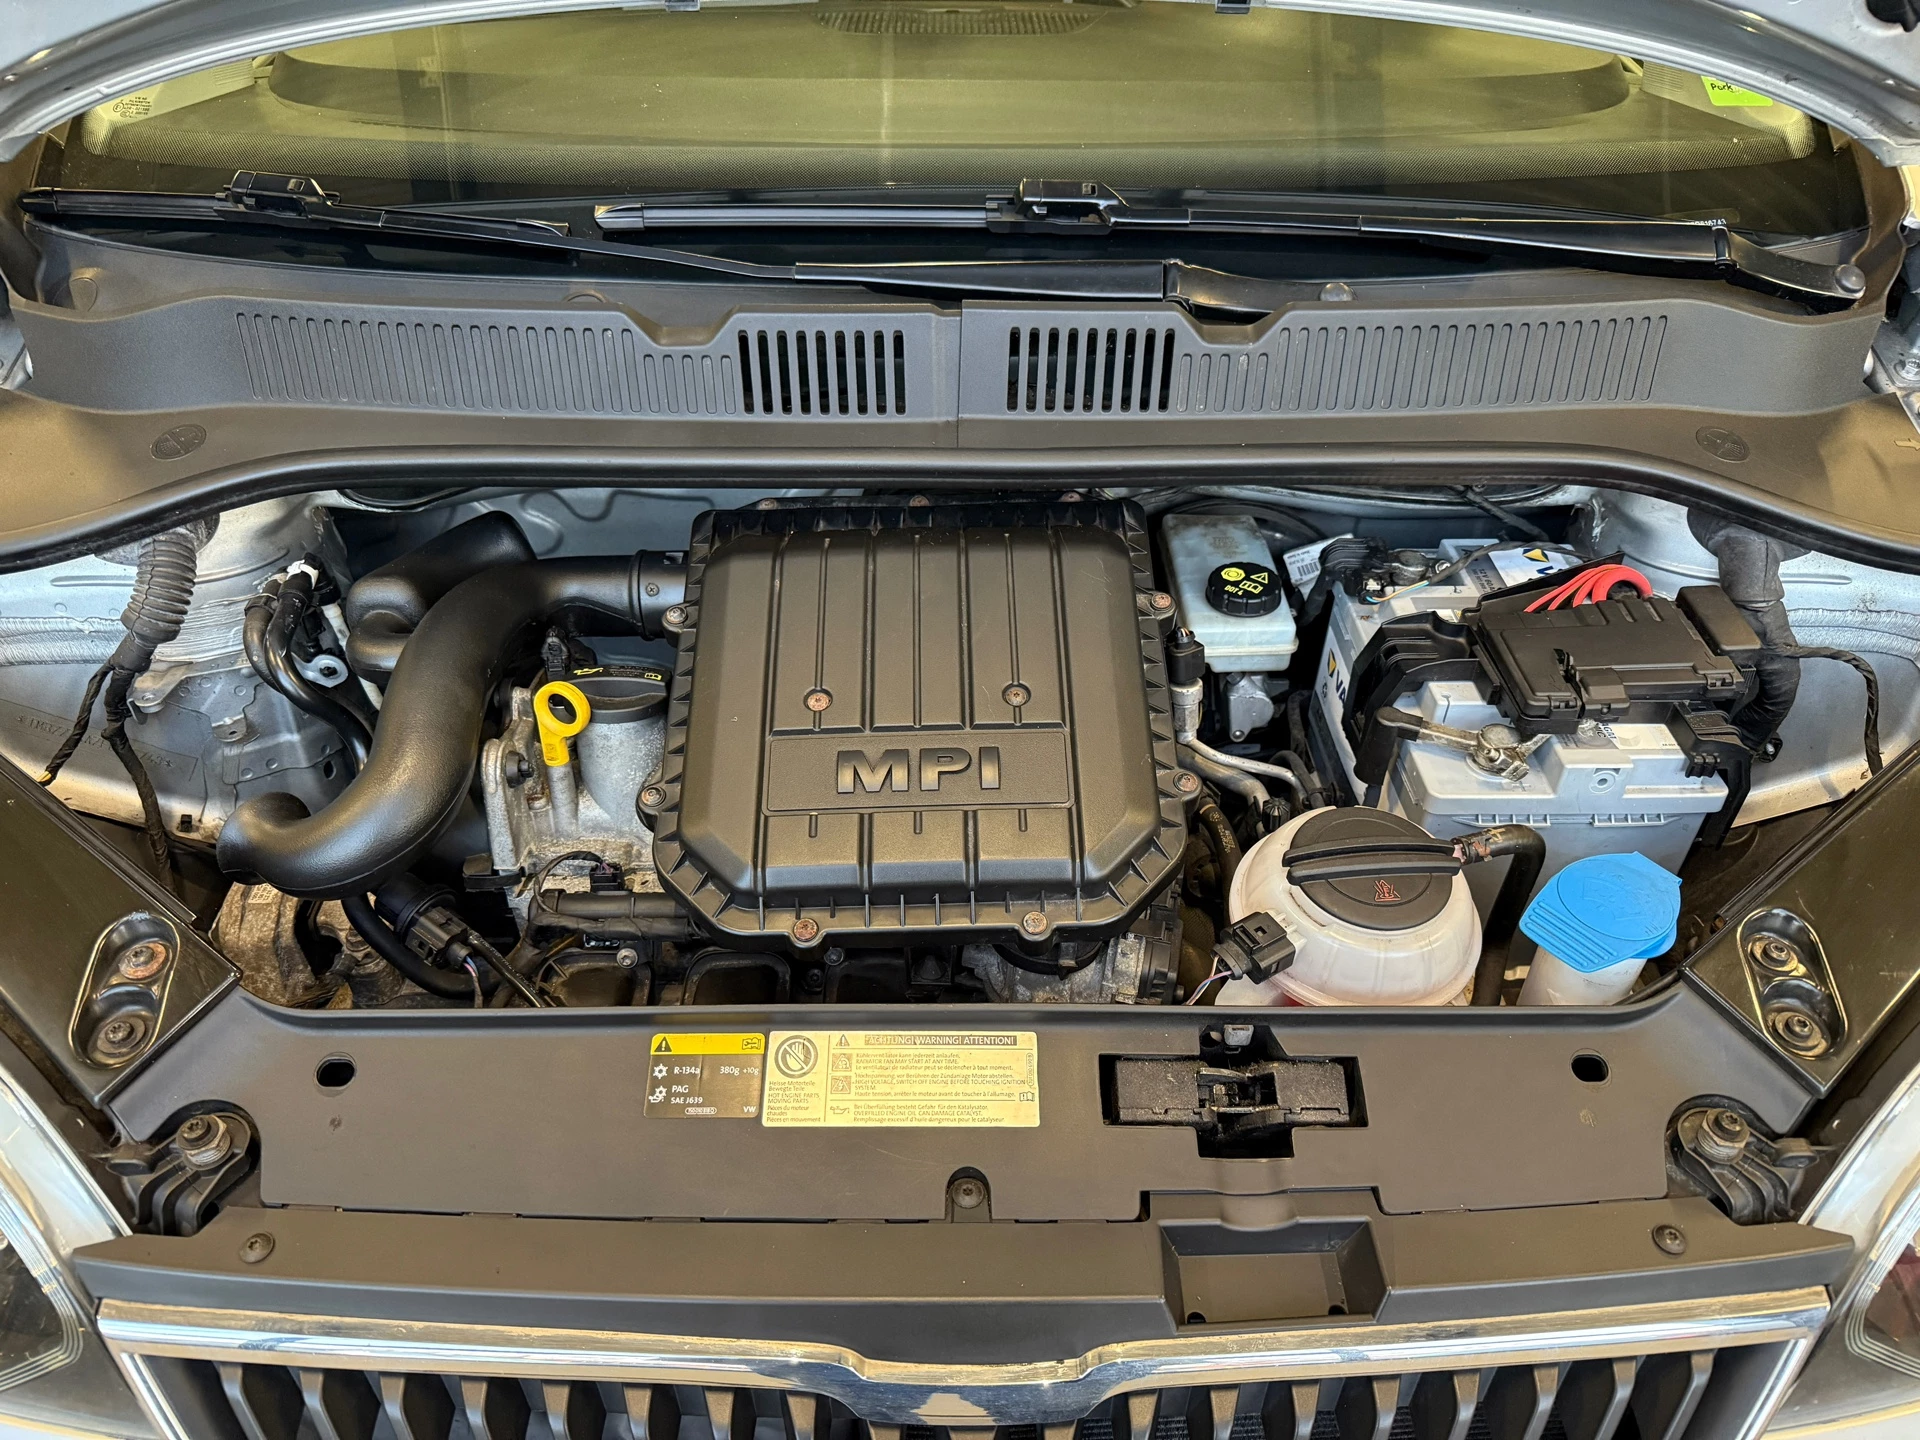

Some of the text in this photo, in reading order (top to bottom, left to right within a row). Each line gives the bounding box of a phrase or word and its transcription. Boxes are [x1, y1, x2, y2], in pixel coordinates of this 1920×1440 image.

[1224, 585, 1237, 594] DOT
[836, 746, 1002, 794] MPI
[915, 1036, 962, 1044] WARNING!
[964, 1036, 1013, 1044] ATTENTION!
[674, 1066, 700, 1074] R-134a
[720, 1066, 740, 1076] 380g
